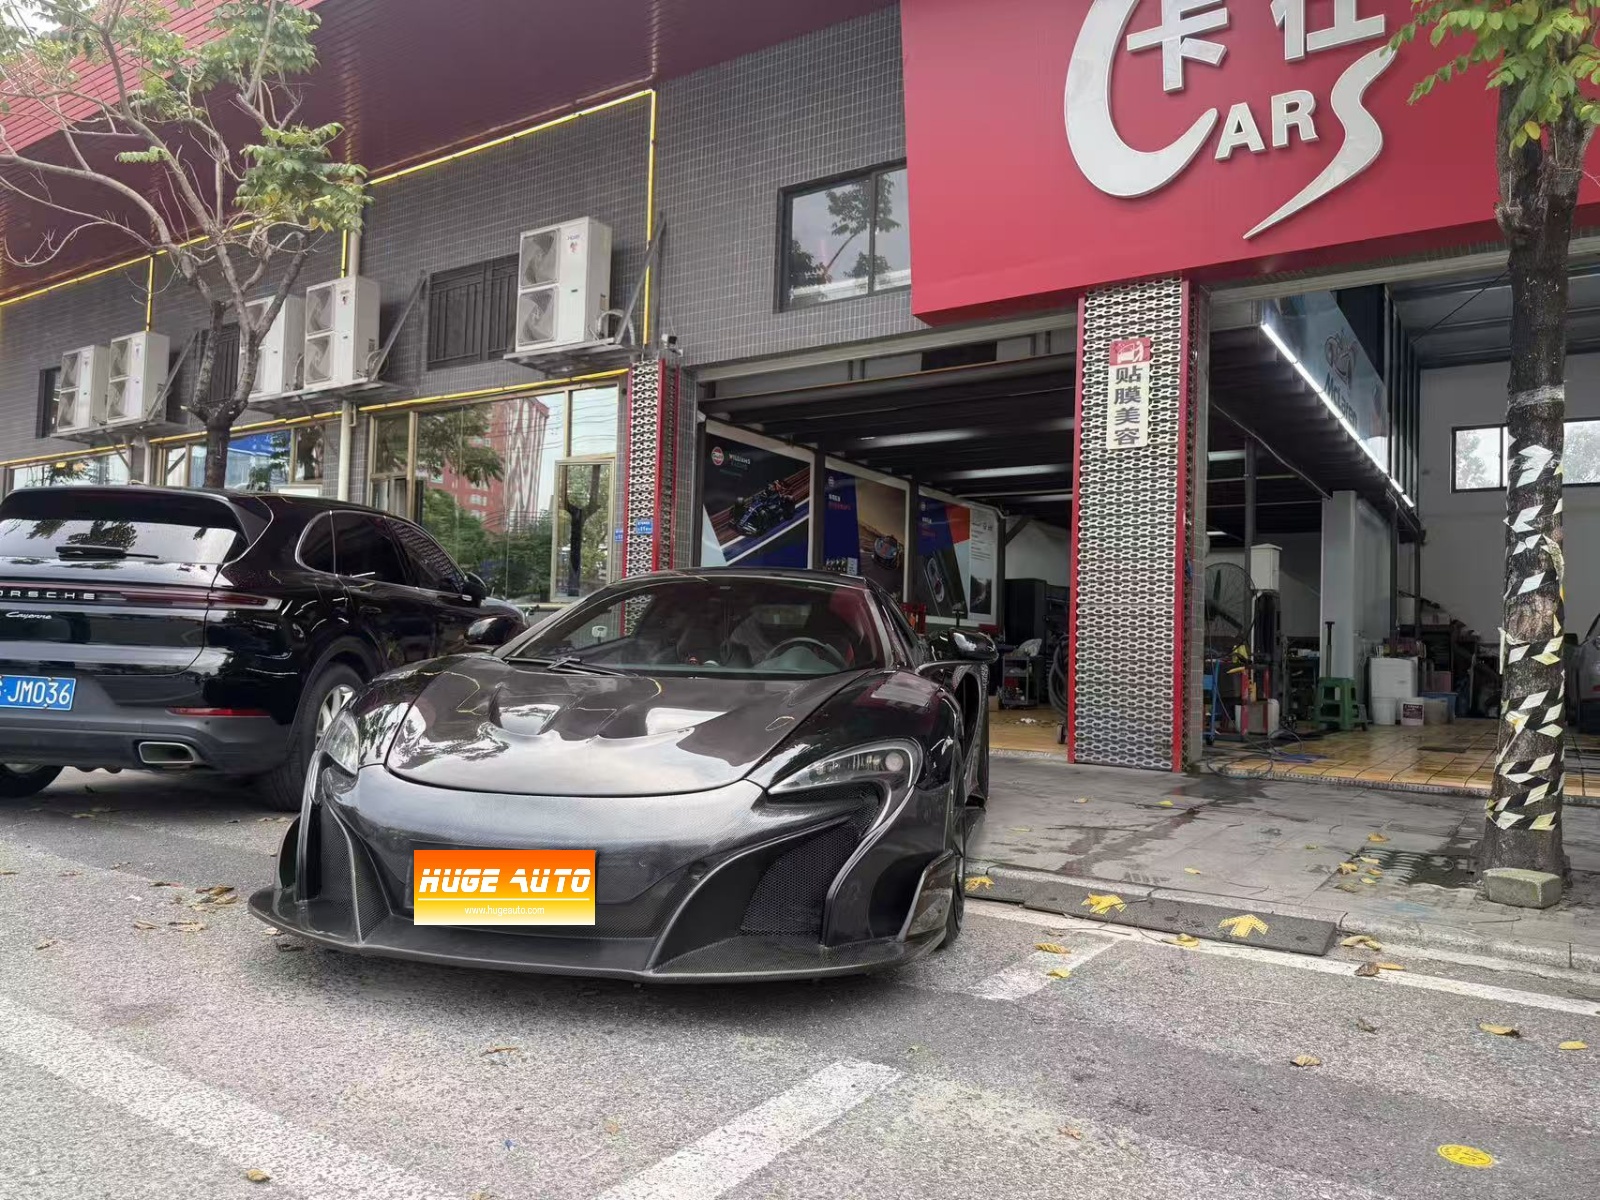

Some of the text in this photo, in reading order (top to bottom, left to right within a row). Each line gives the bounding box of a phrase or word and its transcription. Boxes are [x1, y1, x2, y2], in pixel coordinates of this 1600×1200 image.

[1063, 0, 1397, 240] CARS
[1113, 364, 1144, 446] 贴膜美容
[6, 611, 53, 620] Cayenne
